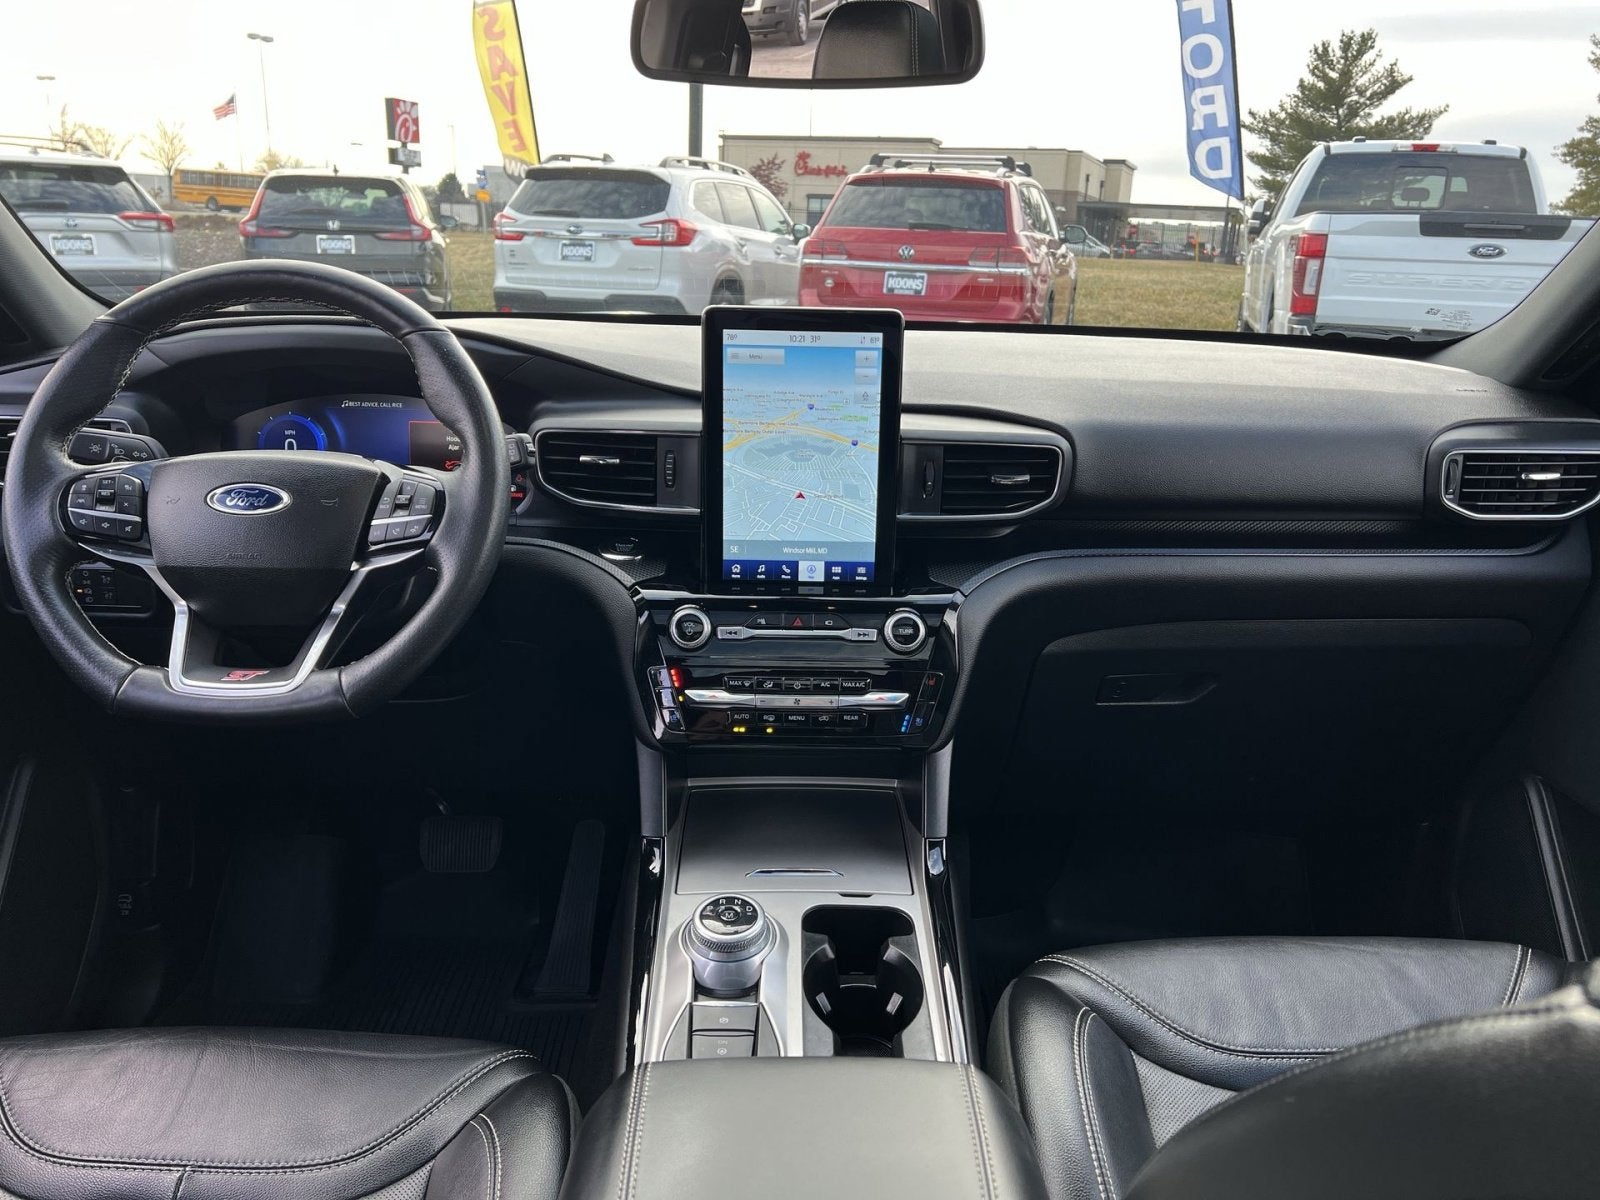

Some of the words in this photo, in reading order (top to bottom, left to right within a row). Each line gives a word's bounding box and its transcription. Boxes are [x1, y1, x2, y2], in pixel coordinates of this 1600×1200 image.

[53, 240, 92, 251] KOONS
[320, 239, 352, 250] KOONS
[562, 246, 592, 256] KOONS
[887, 277, 924, 291] KOONS
[789, 334, 806, 343] 10:21
[730, 545, 739, 553] SE
[782, 546, 805, 554] Windsor
